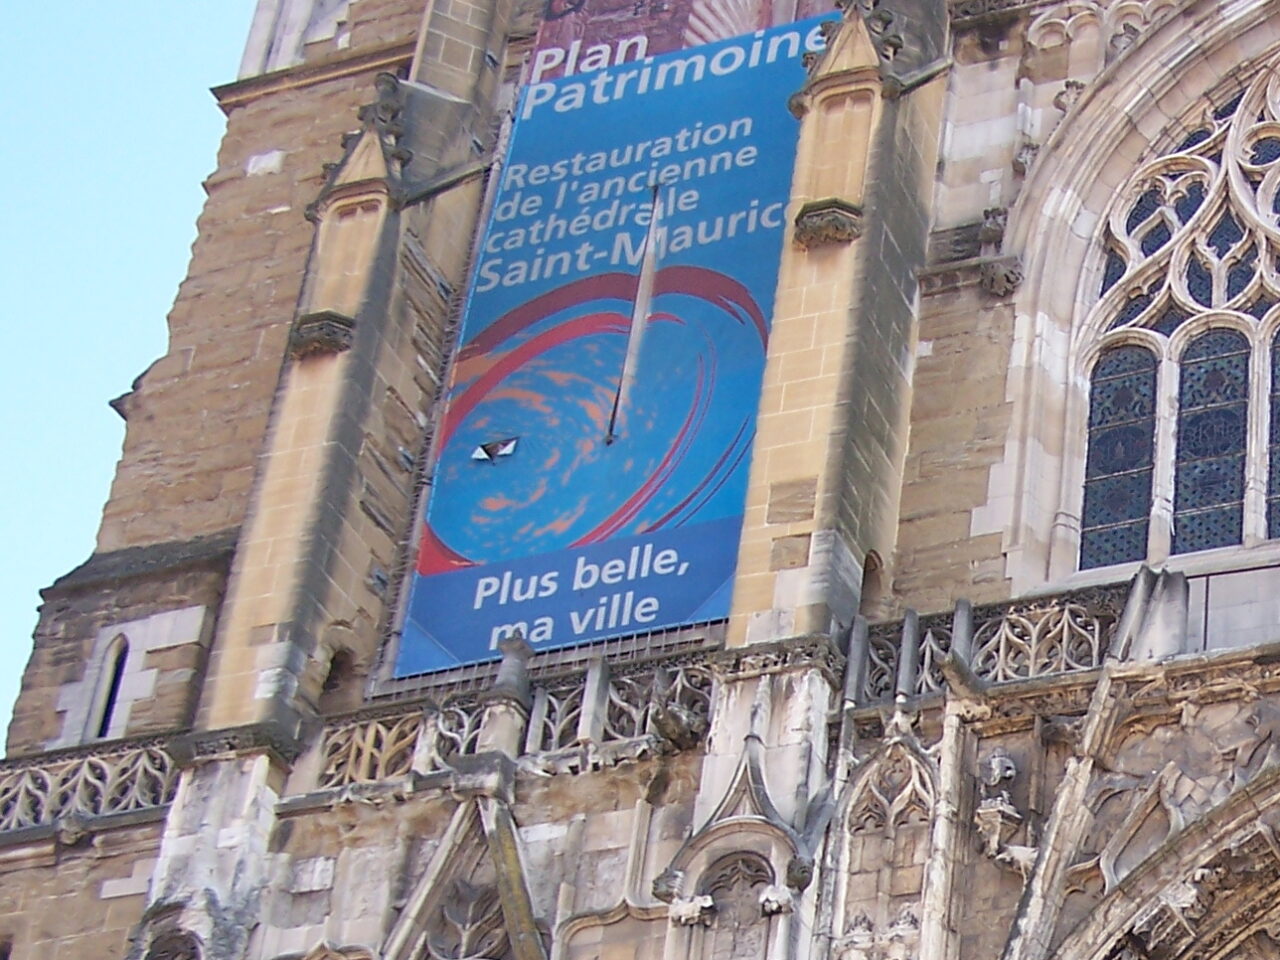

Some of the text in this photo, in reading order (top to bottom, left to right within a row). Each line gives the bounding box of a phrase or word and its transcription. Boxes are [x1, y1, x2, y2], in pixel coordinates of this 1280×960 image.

[521, 25, 826, 120] Patrimoine
[530, 34, 648, 84] Plan
[494, 145, 758, 222] de l'ancienne
[503, 116, 753, 192] Restauration
[476, 198, 791, 292] Saint-Mauric
[486, 187, 699, 254] cathédrale
[473, 543, 690, 610] Plus belle,
[488, 591, 660, 651] ma ville
